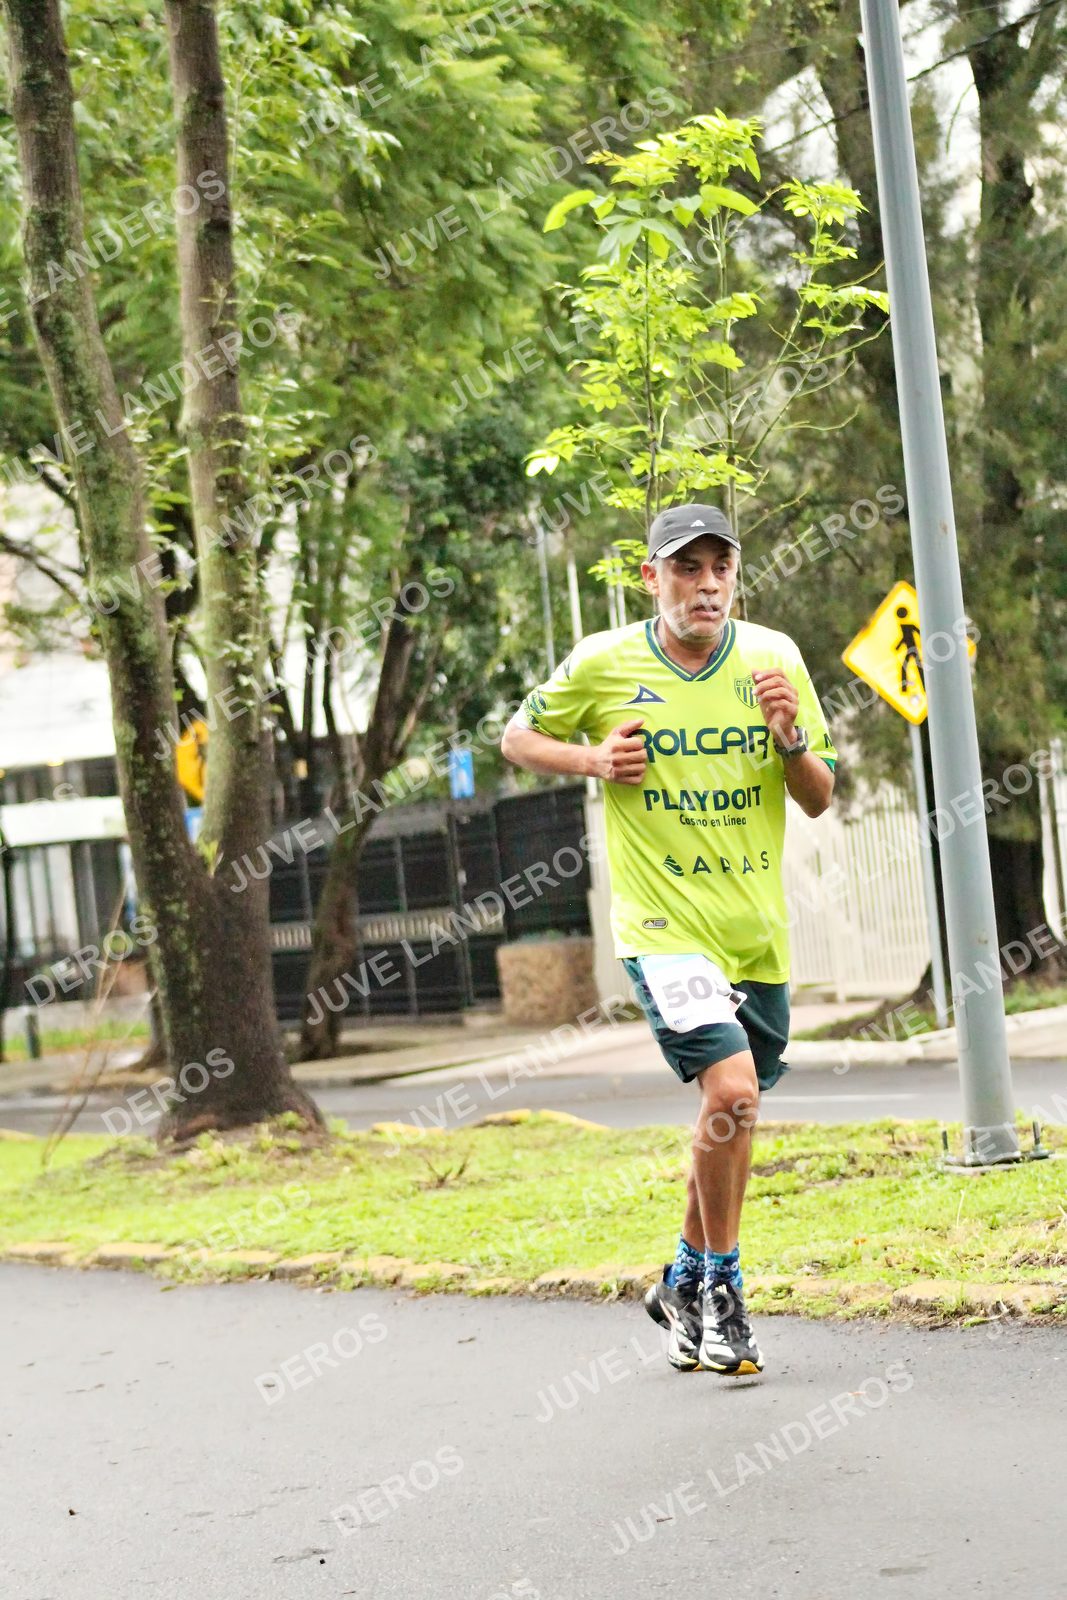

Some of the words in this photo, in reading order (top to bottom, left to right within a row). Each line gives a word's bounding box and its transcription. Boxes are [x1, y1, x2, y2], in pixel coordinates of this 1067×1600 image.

[627, 726, 770, 762] ROLCAR
[643, 785, 761, 811] PLAYDOIT
[692, 850, 769, 874] ARAS
